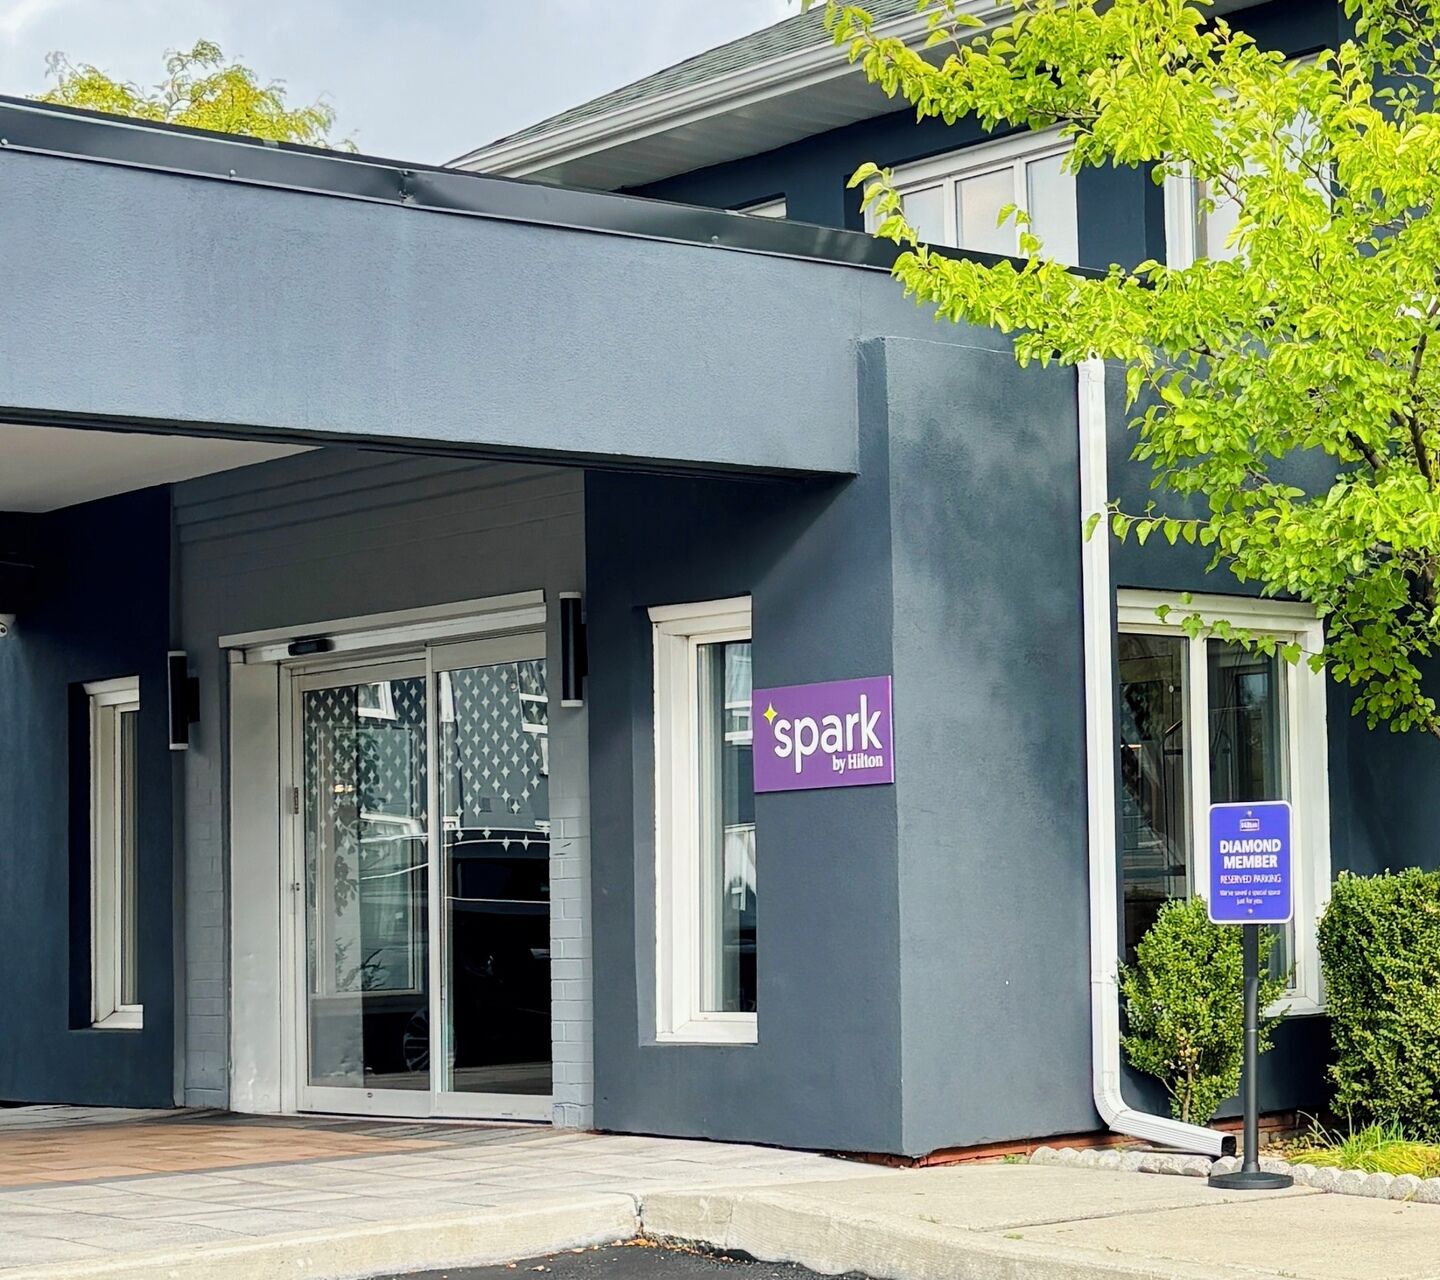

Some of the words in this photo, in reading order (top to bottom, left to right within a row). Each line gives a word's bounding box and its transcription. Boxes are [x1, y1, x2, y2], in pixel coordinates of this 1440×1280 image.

[774, 694, 883, 773] spark
[832, 754, 847, 774] by
[848, 752, 883, 770] Hilton
[1219, 839, 1281, 853] DIAMOND
[1223, 855, 1278, 869] MEMBER
[1220, 874, 1252, 884] RESERVED
[1253, 873, 1281, 883] PARKING
